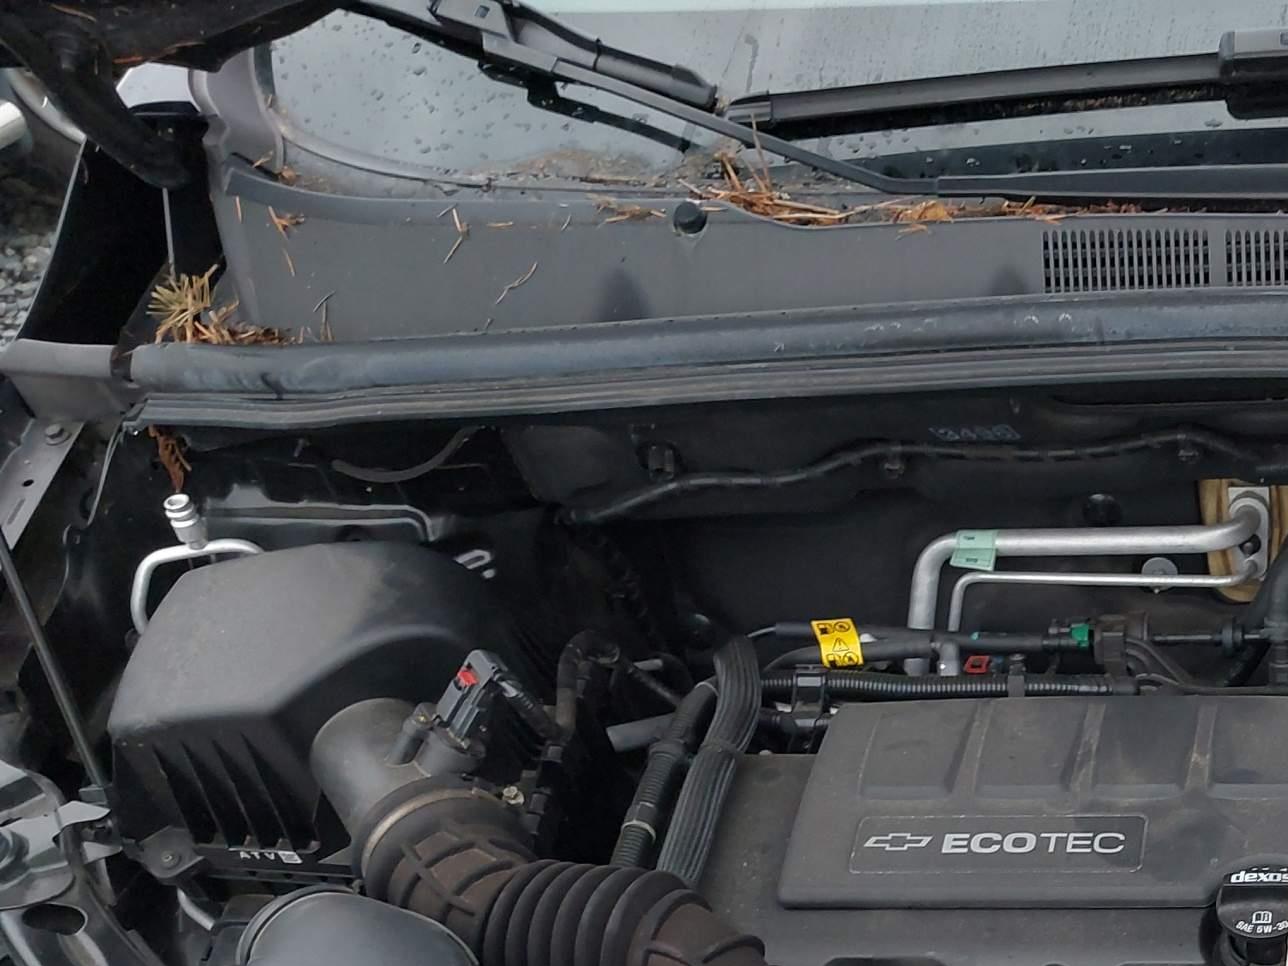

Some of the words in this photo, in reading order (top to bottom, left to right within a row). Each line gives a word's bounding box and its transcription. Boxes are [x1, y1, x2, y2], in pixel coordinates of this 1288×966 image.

[941, 832, 1126, 854] ECOTEC
[240, 851, 276, 860] ATV
[1235, 920, 1255, 934] SAE
